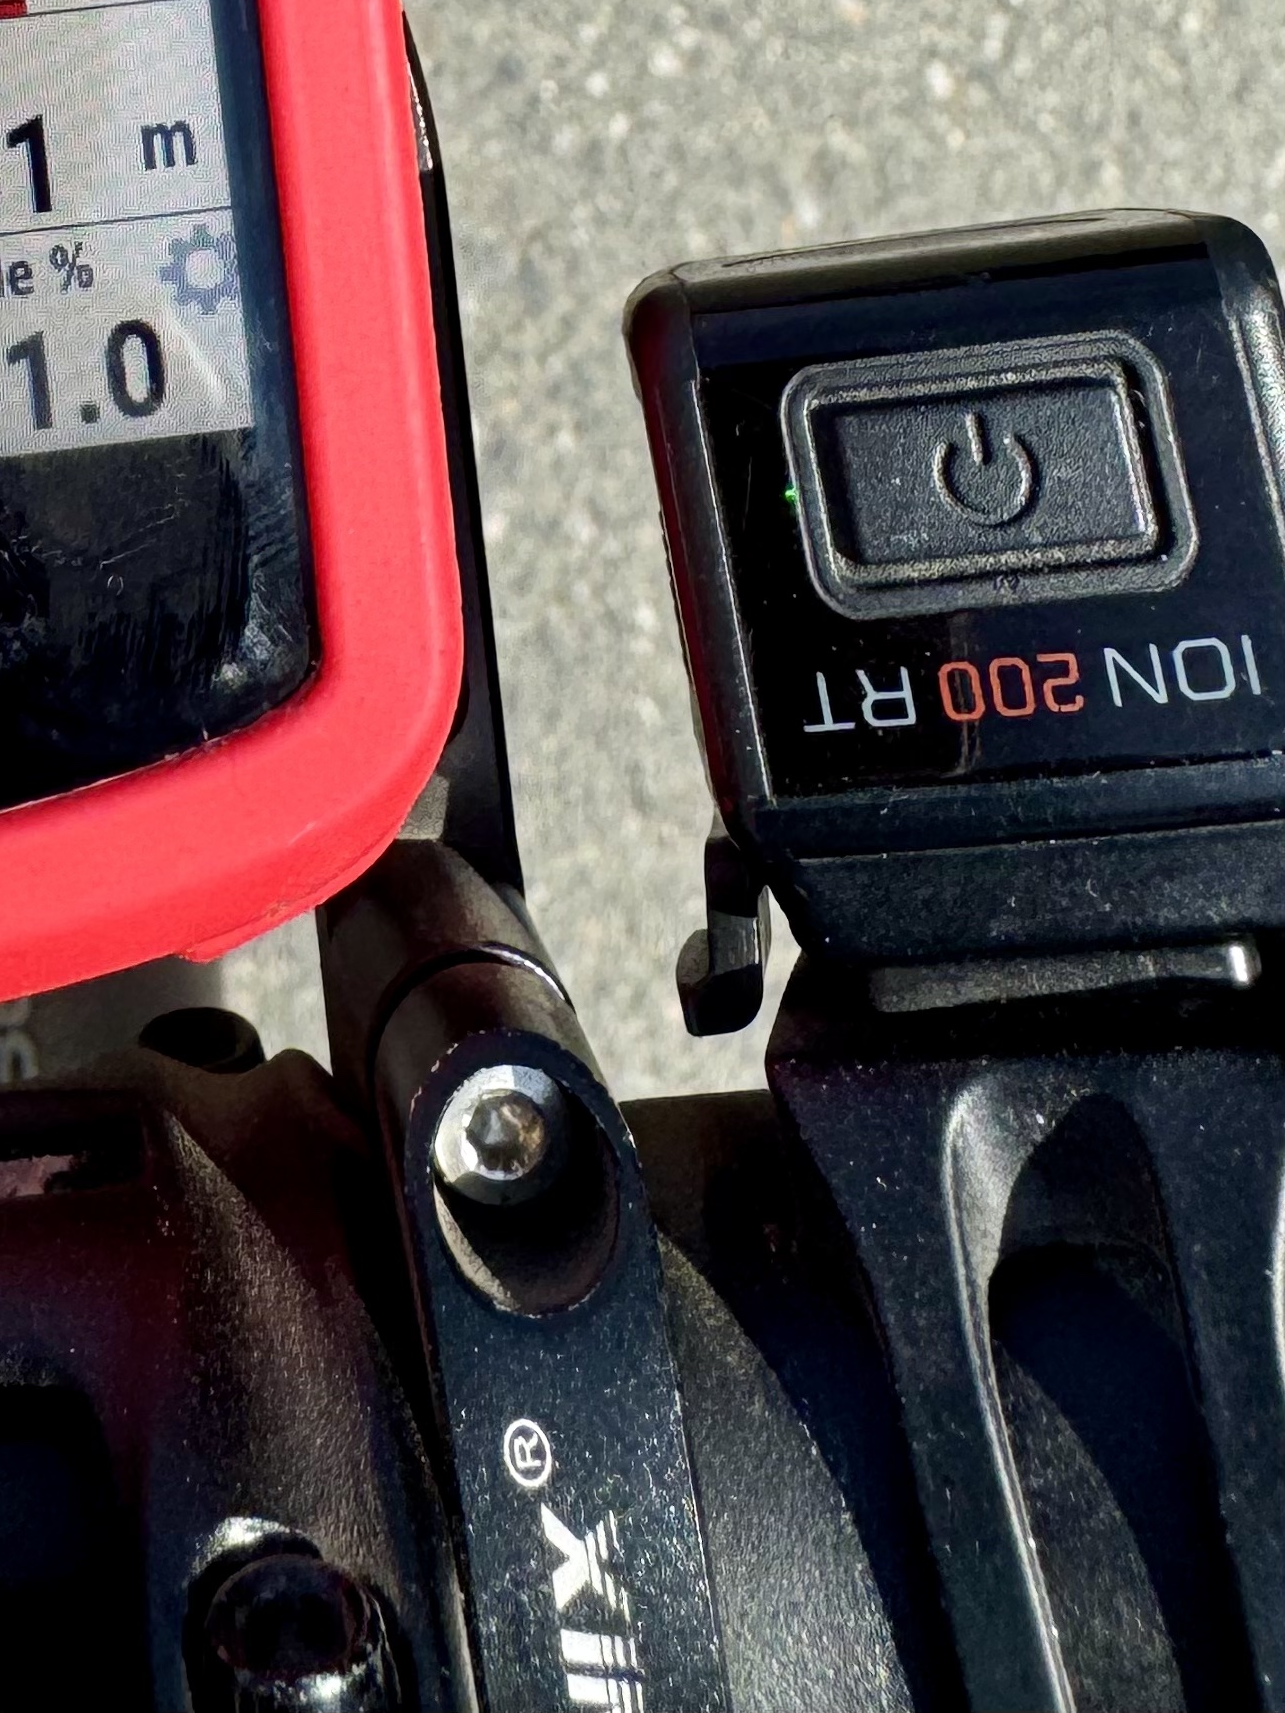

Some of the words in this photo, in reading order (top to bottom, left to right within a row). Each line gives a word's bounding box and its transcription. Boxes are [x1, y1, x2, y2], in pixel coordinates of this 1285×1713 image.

[141, 120, 198, 171] m
[49, 241, 93, 294] %
[804, 666, 916, 732] RT
[938, 653, 1084, 721] 200
[1104, 635, 1261, 707] ION
